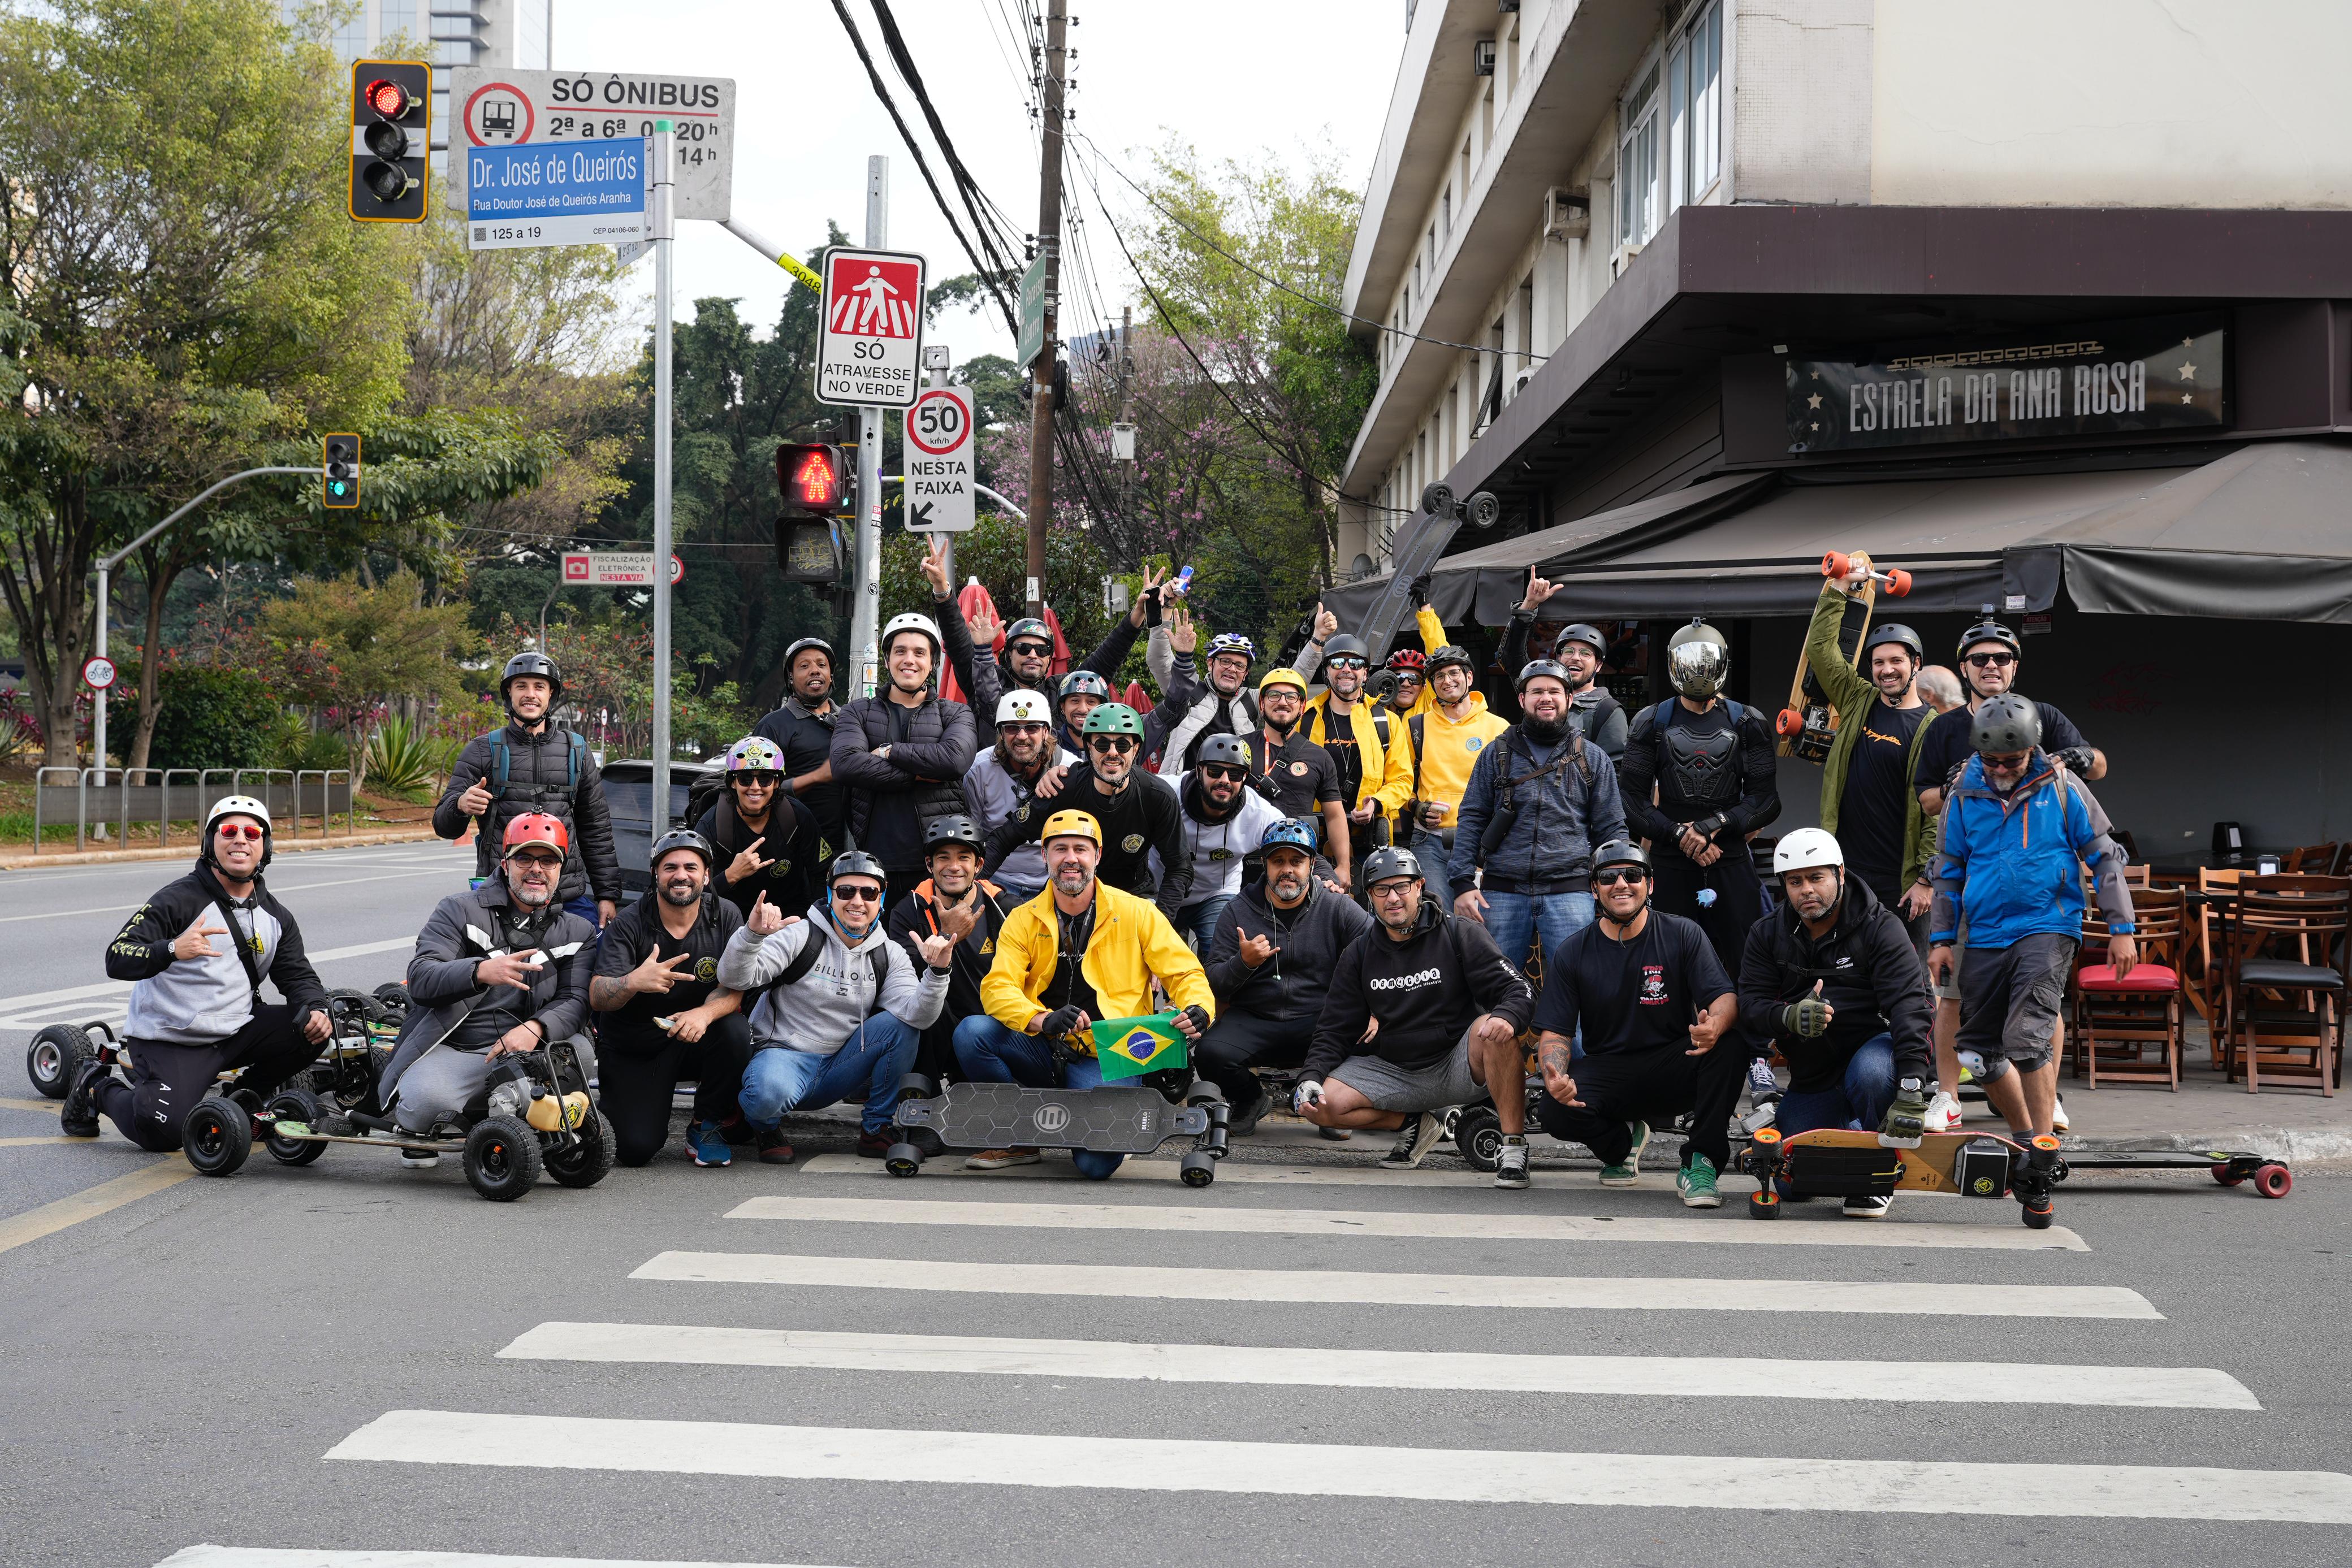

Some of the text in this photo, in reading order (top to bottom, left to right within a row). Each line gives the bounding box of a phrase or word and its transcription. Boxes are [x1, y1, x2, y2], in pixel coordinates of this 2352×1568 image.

[552, 73, 719, 108] SÓ ÔNIBUS
[550, 117, 574, 136] 2ª
[582, 122, 594, 137] a
[602, 119, 626, 138] 6ª
[677, 122, 704, 141] 20
[709, 123, 717, 135] h
[679, 146, 716, 165] 14 h
[473, 149, 637, 188] Dr. José de Queirós
[474, 192, 631, 210] Rua Doutor José de Queirós Aranha
[492, 227, 541, 240] 125 a 19
[790, 266, 822, 292] 3048
[1024, 316, 1040, 346] Centro
[853, 338, 885, 360] SÓ
[824, 363, 912, 382] ATRAVESSE
[828, 380, 905, 397] NO VERDE
[1849, 359, 2146, 432] ESTRELA DA ANA ROSA
[920, 406, 958, 434] 50
[930, 436, 950, 445] km/h
[911, 461, 967, 476] NESTA
[915, 481, 965, 495] FAIXA
[593, 555, 651, 564] FISCALIZAÇÃO
[155, 1083, 171, 1123] AIR
